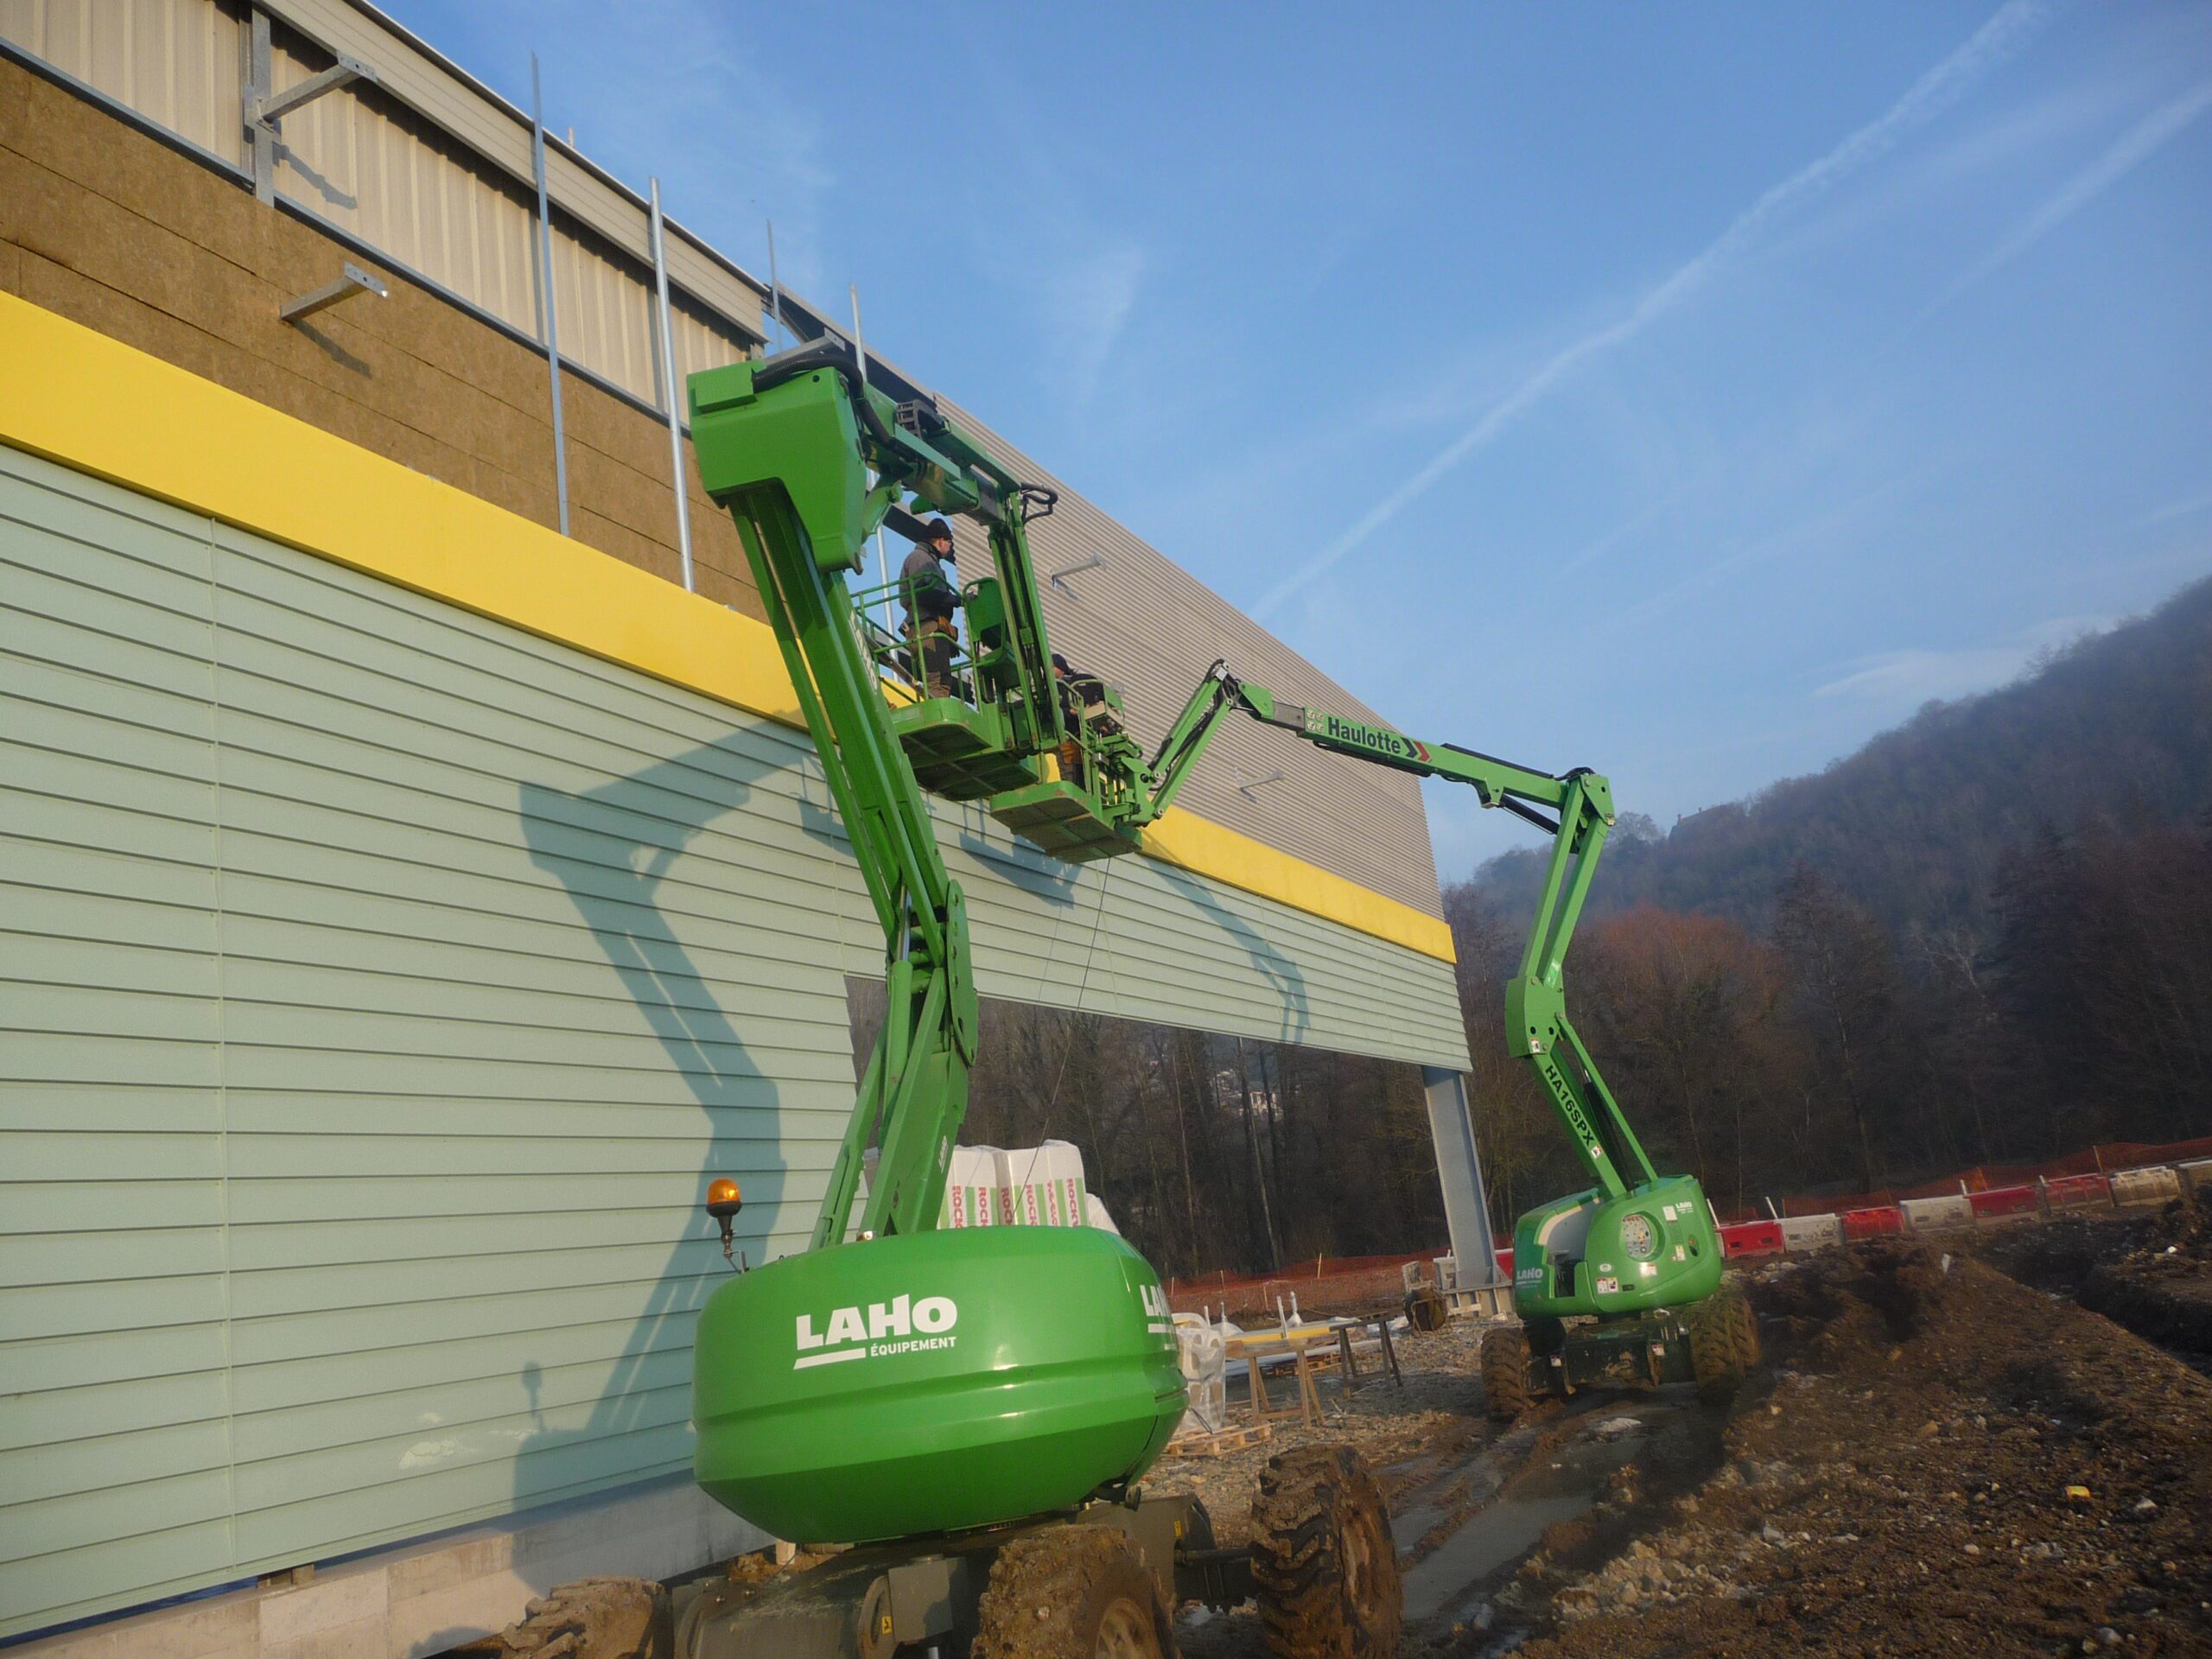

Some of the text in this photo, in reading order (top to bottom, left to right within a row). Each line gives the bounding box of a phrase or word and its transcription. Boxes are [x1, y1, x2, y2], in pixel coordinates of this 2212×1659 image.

[1327, 716, 1402, 754] Haulotte
[1545, 1065, 1595, 1147] HA16SPX
[1516, 1266, 1544, 1281] LAHO
[1139, 1283, 1171, 1317] LAH
[796, 1294, 957, 1351] LAHO
[870, 1336, 957, 1357] ÉQUIPEMENT
